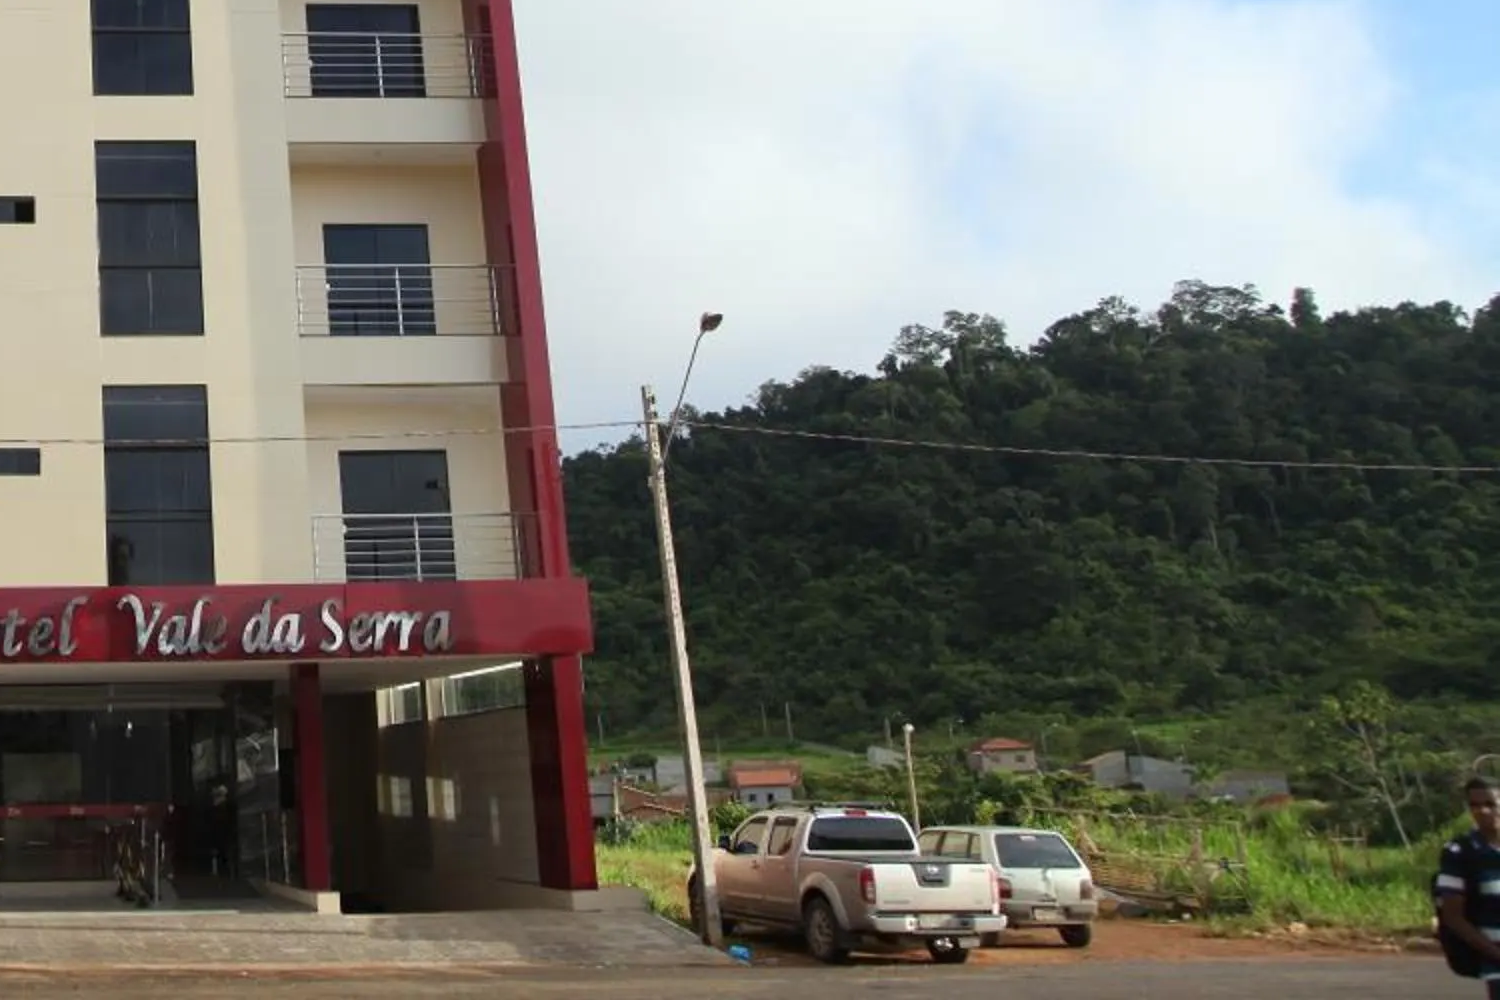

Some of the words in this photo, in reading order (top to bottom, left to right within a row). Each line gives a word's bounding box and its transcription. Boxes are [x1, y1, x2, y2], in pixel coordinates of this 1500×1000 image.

[116, 593, 228, 655] Vale
[242, 594, 305, 654] da
[319, 598, 454, 652] Serra
